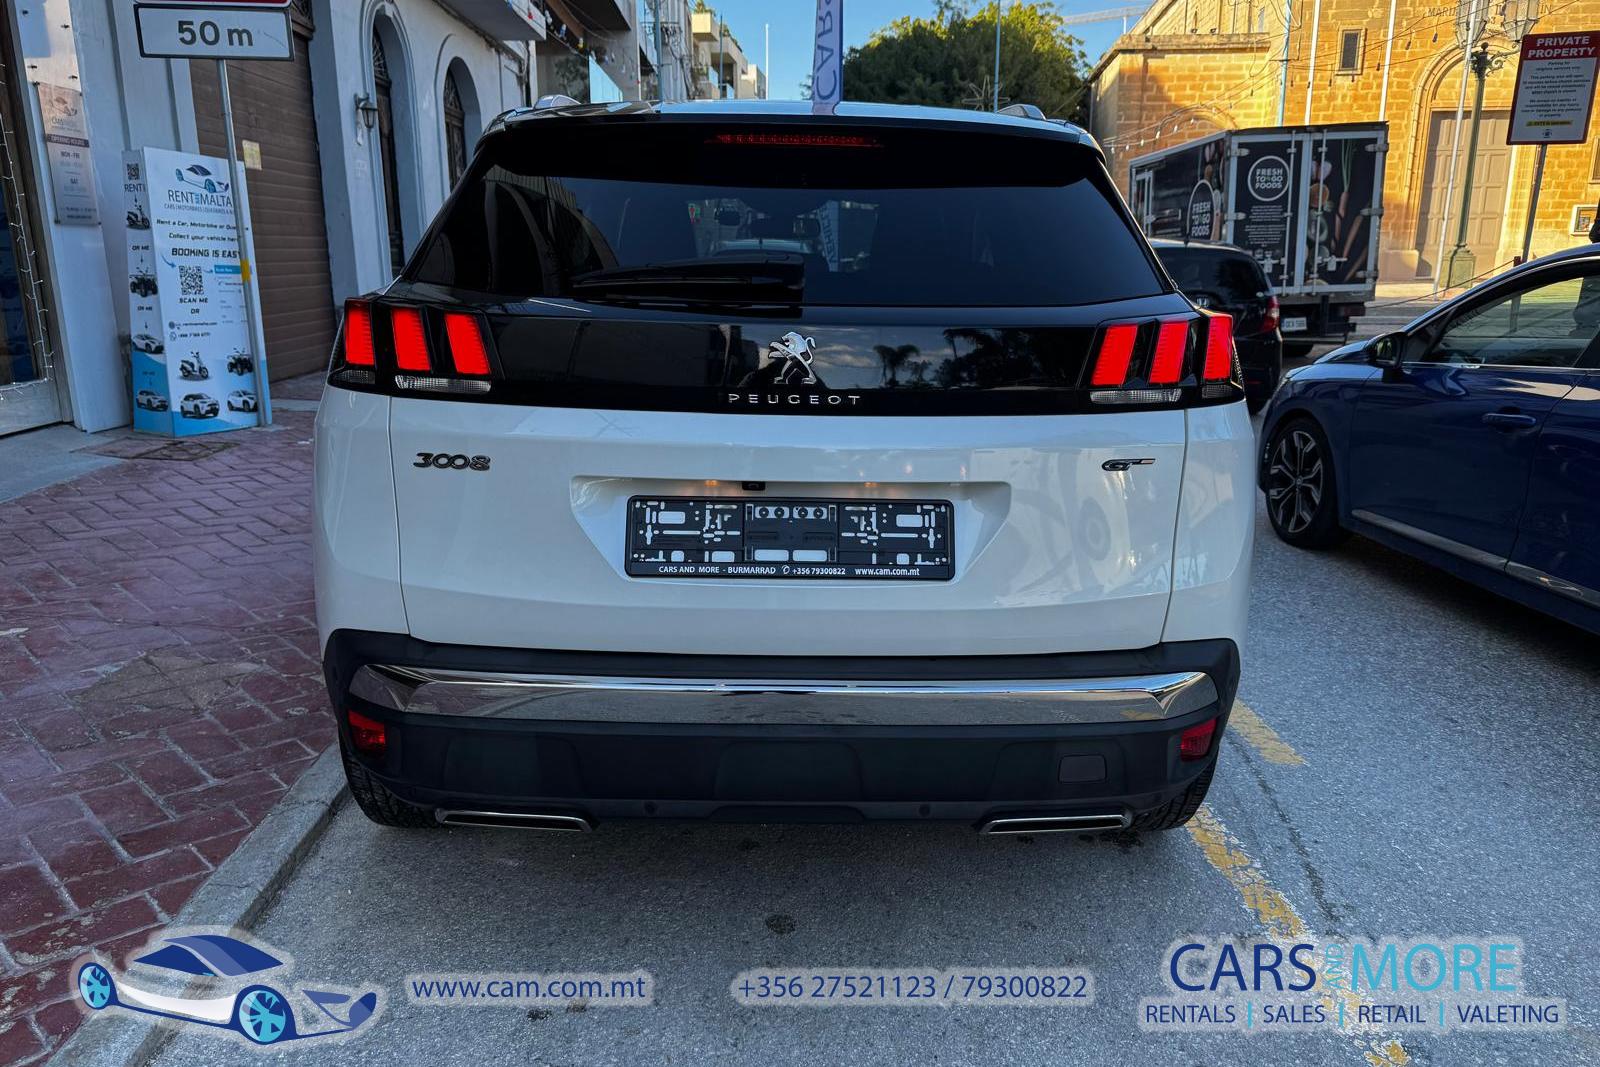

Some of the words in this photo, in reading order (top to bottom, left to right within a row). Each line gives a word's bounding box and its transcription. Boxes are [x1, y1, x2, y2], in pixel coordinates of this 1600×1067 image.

[178, 20, 220, 46] 50
[227, 28, 254, 47] m
[1536, 36, 1590, 47] PRIVATE
[1527, 47, 1596, 58] PROPERTY
[1256, 168, 1283, 176] FRESH
[168, 189, 195, 204] RENT
[200, 193, 233, 208] MALTA
[1192, 201, 1211, 214] FRESH
[1191, 224, 1210, 237] FOODS
[168, 232, 189, 240] Collect
[191, 234, 205, 242] your
[172, 248, 209, 258] BOOKING
[212, 249, 220, 258] IS
[728, 393, 860, 406] PEUGEOT
[413, 452, 491, 471] 3008
[727, 566, 776, 574] BURMARRAD
[793, 567, 811, 575] +356
[811, 567, 846, 575] 79300822
[855, 568, 920, 576] www.cam.com.mt
